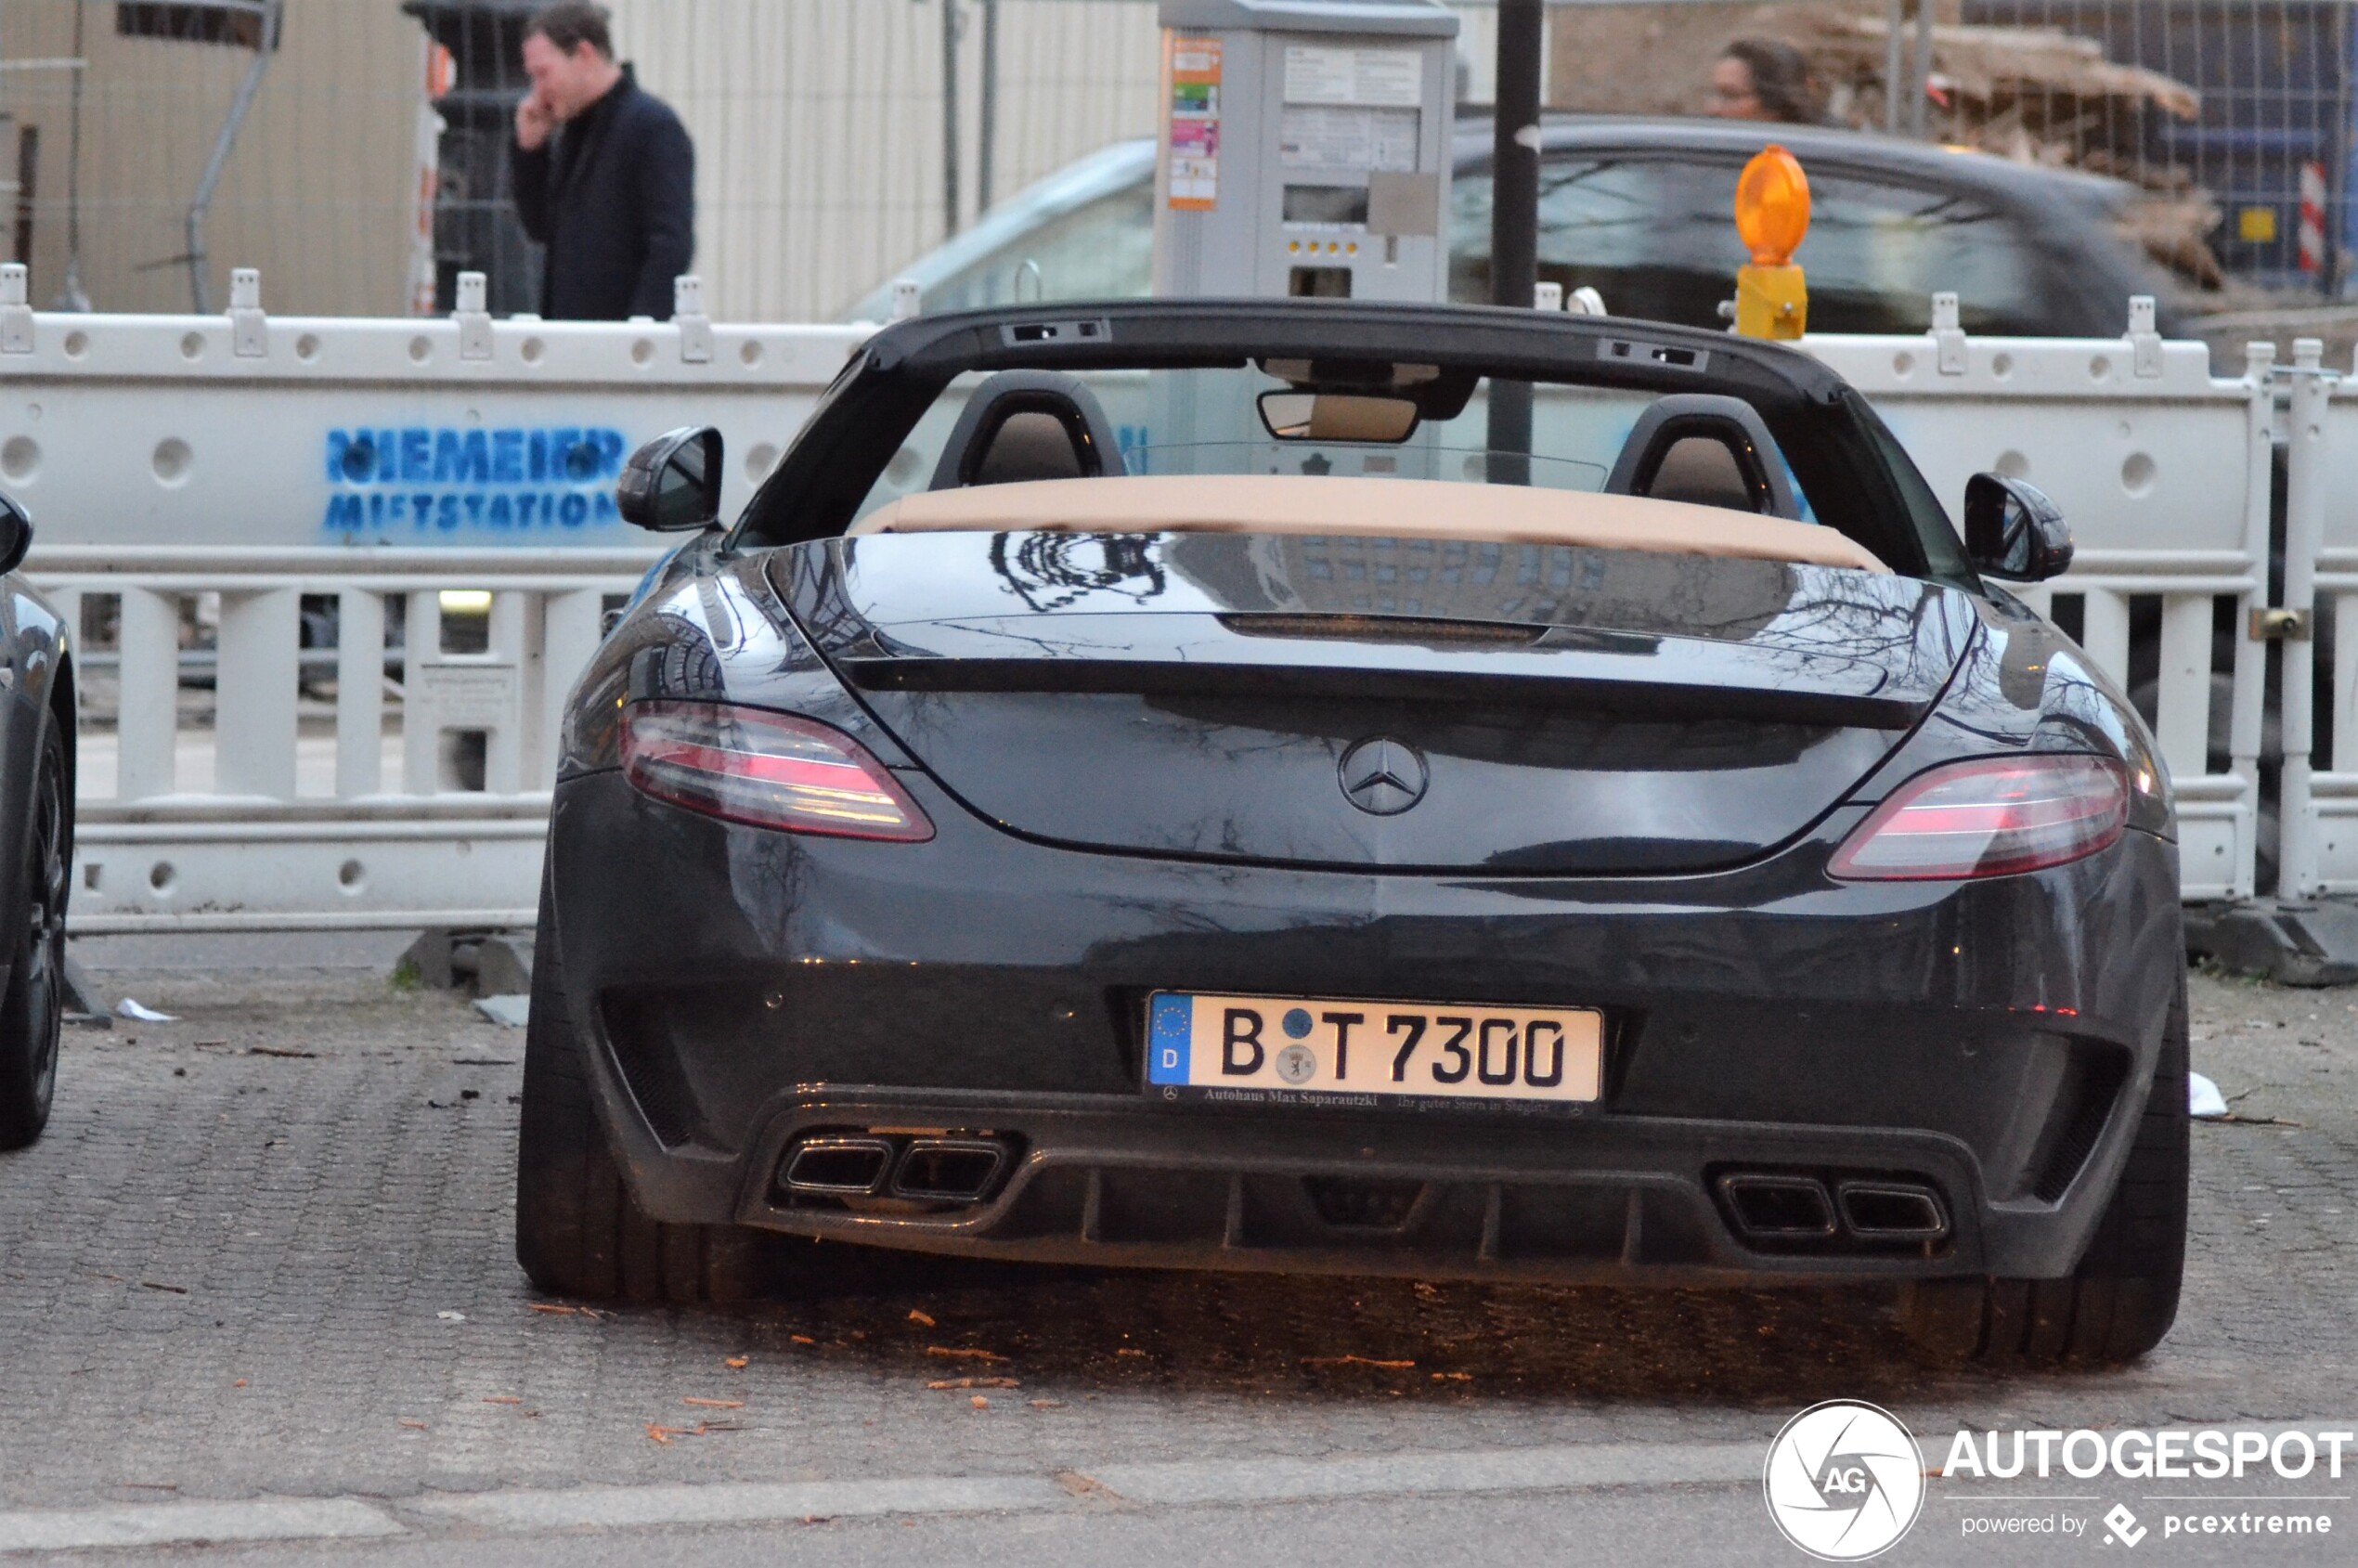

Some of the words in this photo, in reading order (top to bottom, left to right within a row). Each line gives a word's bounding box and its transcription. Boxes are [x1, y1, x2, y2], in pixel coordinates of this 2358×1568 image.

[1221, 1008, 1264, 1077] B
[1321, 1012, 1365, 1081] T
[1383, 1015, 1564, 1088] 7300
[1162, 1049, 1178, 1069] D
[1204, 1088, 1264, 1103] Autohaus
[1268, 1091, 1297, 1104] Max
[1301, 1093, 1379, 1108] Saparautzki
[1397, 1095, 1416, 1108] Ihr
[1419, 1098, 1451, 1112] guter
[1455, 1097, 1486, 1110] Stern
[1489, 1099, 1502, 1111] in
